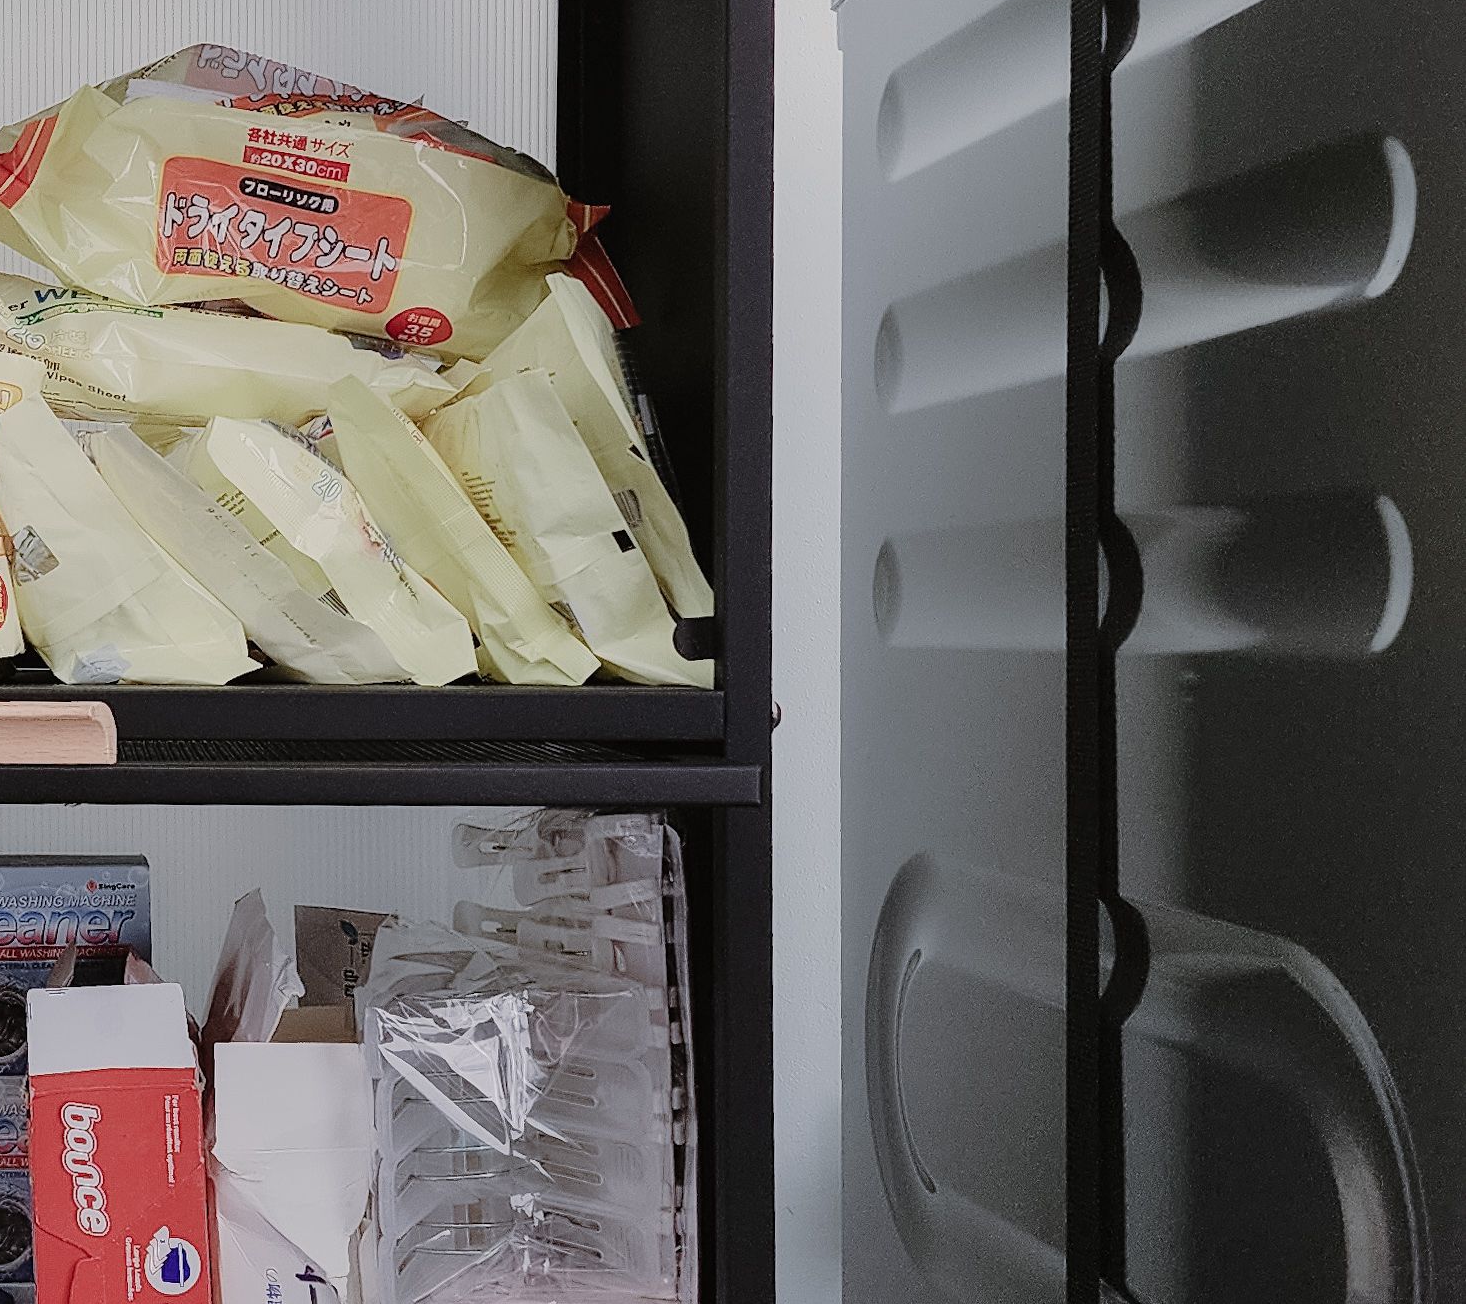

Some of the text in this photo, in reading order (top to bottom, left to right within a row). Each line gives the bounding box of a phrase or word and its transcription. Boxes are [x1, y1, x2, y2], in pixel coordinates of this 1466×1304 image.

[247, 127, 354, 159] 各社共通サイズ
[163, 192, 397, 281] ドライタイプシート
[404, 325, 435, 338] 35
[97, 882, 135, 891] SingCare
[68, 895, 136, 907] MACHINE
[0, 948, 17, 959] ALL
[60, 1100, 110, 1237] bounce
